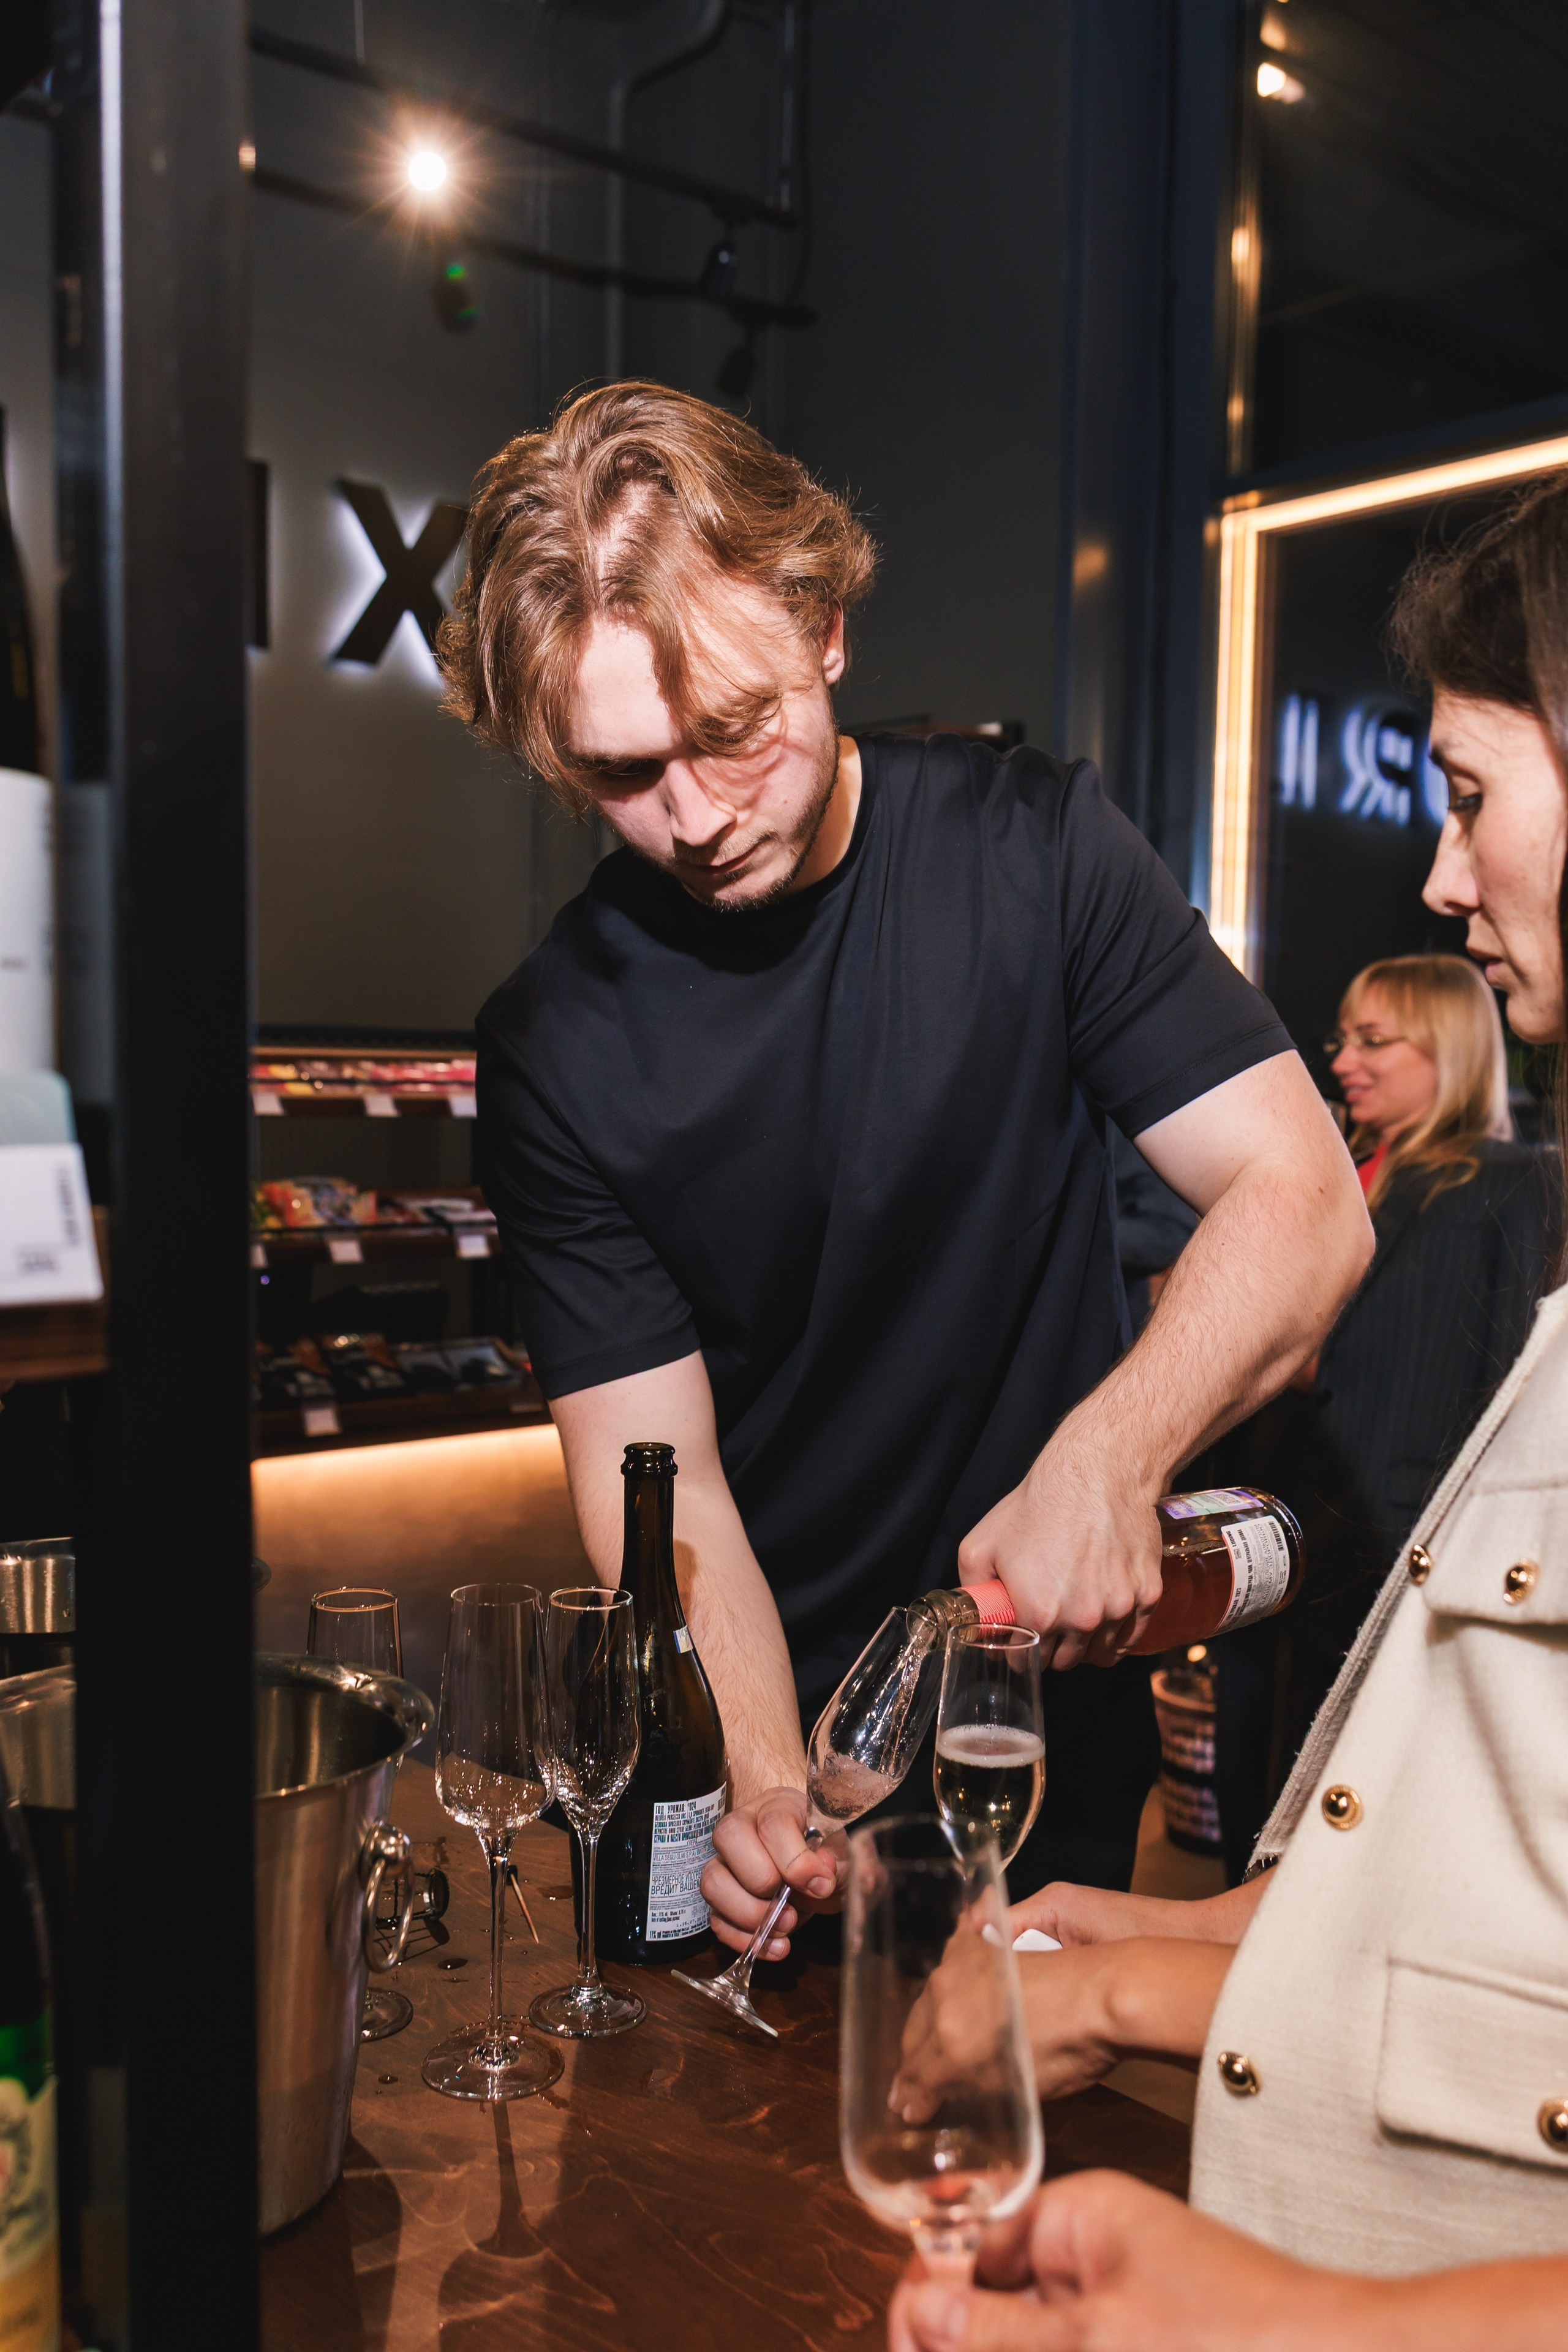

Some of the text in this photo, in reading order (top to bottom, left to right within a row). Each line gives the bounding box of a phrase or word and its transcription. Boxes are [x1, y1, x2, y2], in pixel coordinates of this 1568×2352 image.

[1226, 1531, 1237, 1547] LUDING
[1242, 1541, 1253, 1563] ЦЕНТРАЛЬНАЯ
[655, 1805, 664, 1815] ГОД
[668, 1803, 686, 1814] УРОЖАЯ:
[654, 1834, 666, 1843] СТРАНА
[671, 1833, 680, 1842] МЕСТО
[652, 1874, 684, 1885] ЧРЕЗМЕРНОЕ
[651, 1884, 678, 1896] ВРЕДИТ
